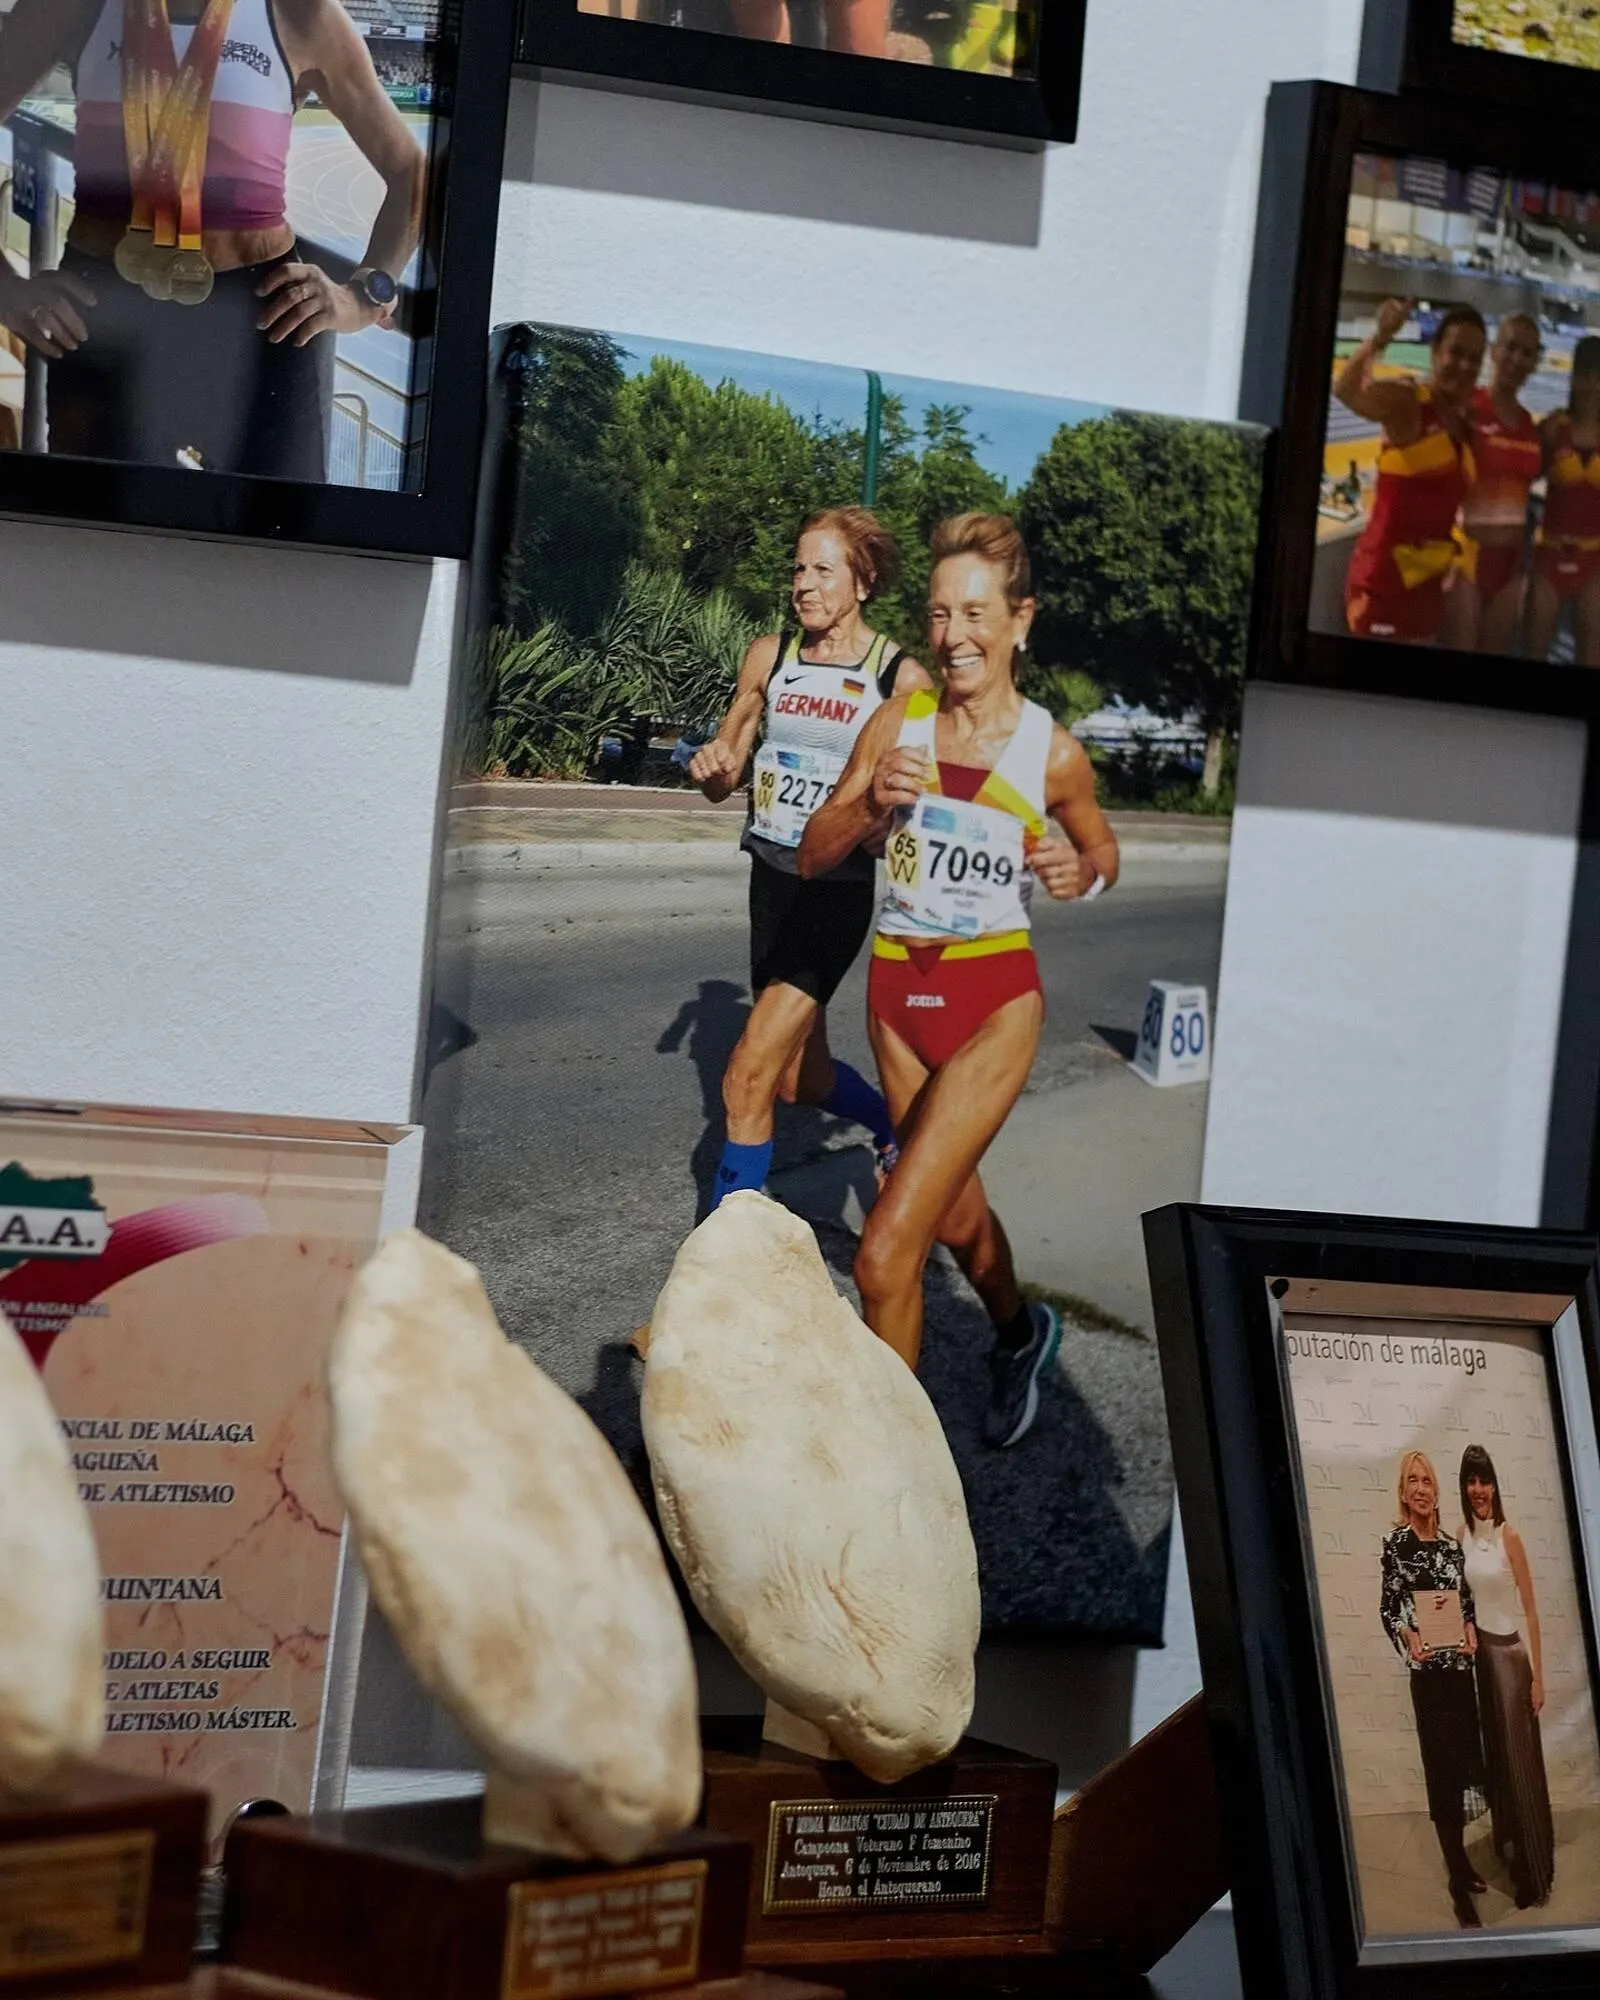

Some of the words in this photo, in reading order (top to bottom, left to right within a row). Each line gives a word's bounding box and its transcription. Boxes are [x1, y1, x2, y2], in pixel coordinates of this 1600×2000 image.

[775, 692, 860, 725] GERMANY
[760, 771, 775, 788] 60
[894, 833, 917, 858] 65
[888, 856, 918, 884] W
[927, 839, 1014, 886] 7099
[1170, 1011, 1205, 1058] 80
[1380, 1333, 1405, 1364] de
[1410, 1337, 1487, 1376] málaga
[129, 1421, 160, 1440] DE
[165, 1419, 255, 1443] MÁLAGA
[111, 1483, 235, 1504] ATLETISMO
[100, 1577, 223, 1600] UINTANA
[103, 1651, 167, 1670] DELO
[170, 1651, 186, 1670] A
[191, 1650, 271, 1671] SEGUIR
[123, 1681, 219, 1701] ATLETAS
[204, 1706, 297, 1730] MÁSTER.
[856, 1835, 903, 1854] Veterano
[922, 1831, 972, 1851] femenino
[844, 1857, 854, 1875] 6
[858, 1857, 871, 1875] de
[877, 1854, 932, 1874] Noviembre
[936, 1853, 950, 1872] de
[954, 1851, 982, 1870] 2016
[817, 1880, 852, 1898] Horno
[857, 1878, 868, 1896] el
[873, 1877, 942, 1898] Antequerano
